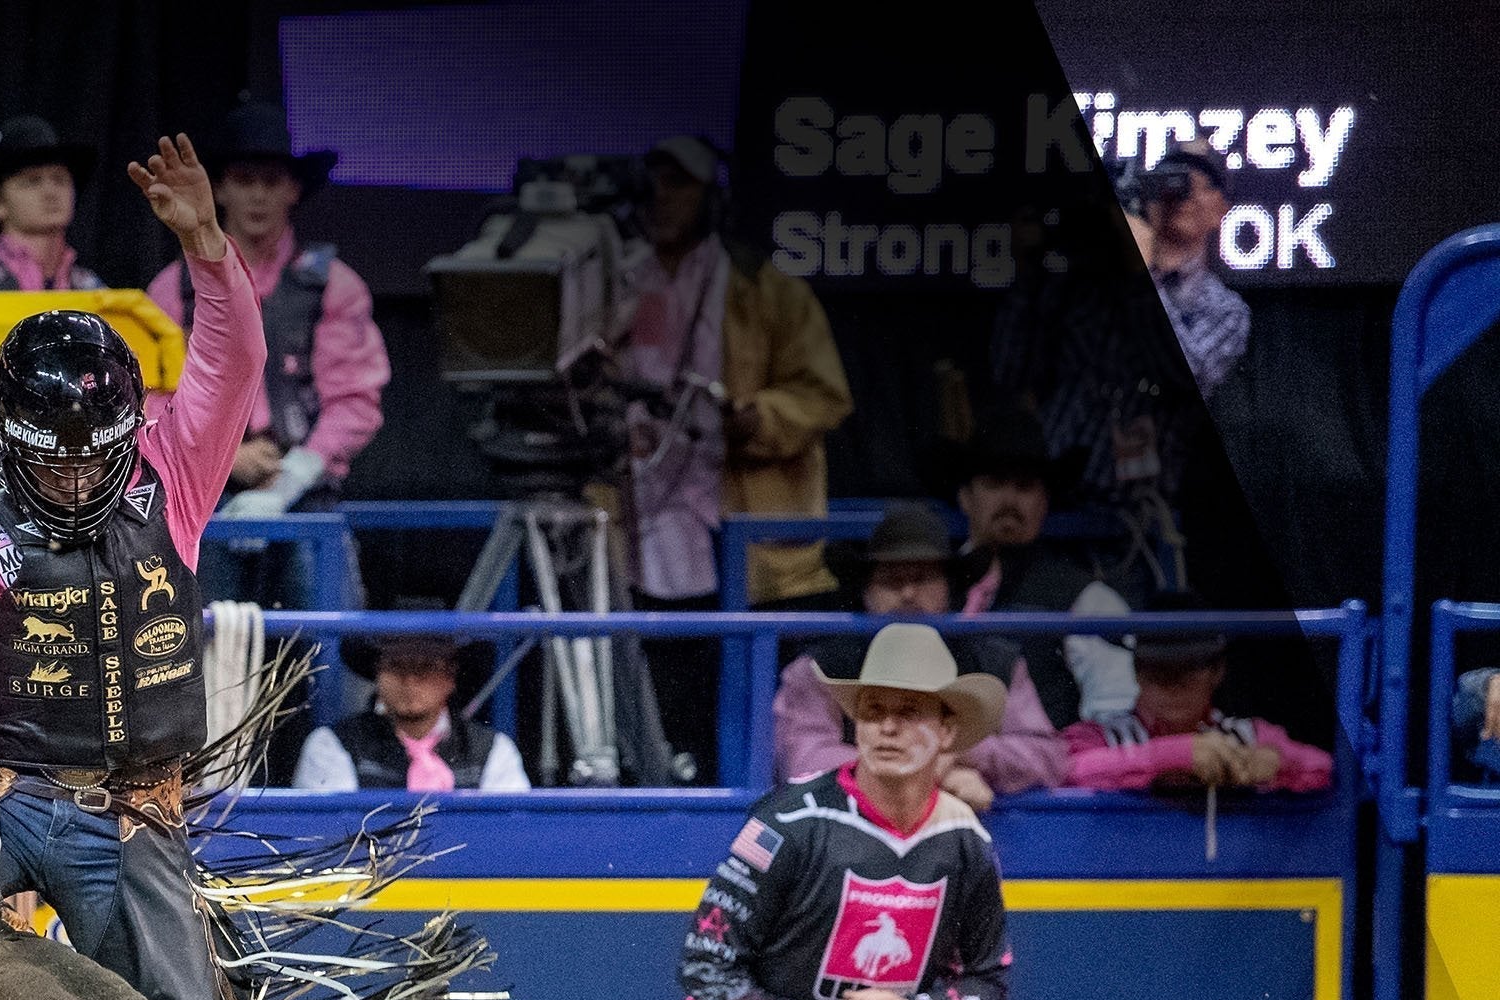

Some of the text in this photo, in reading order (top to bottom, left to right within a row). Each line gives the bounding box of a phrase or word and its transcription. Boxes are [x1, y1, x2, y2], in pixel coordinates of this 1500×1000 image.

[774, 92, 1355, 194] Sage Kimzey
[772, 210, 1016, 288] Strong
[1220, 203, 1336, 270] OK
[9, 586, 90, 614] Wrangler
[100, 580, 119, 641] SAGE
[13, 641, 41, 654] MGM
[12, 680, 90, 697] SURGE
[104, 655, 126, 743] STEELE
